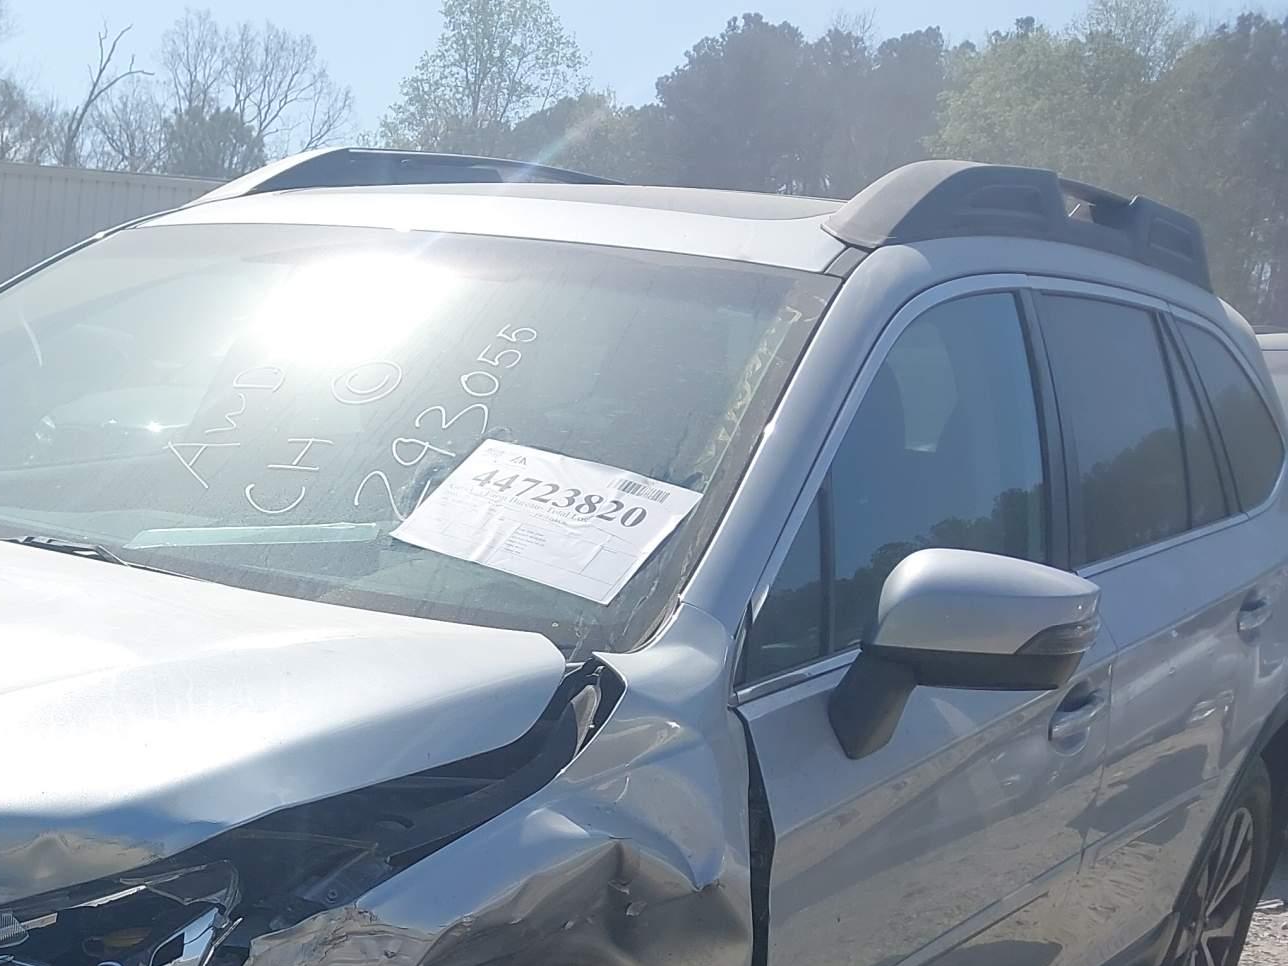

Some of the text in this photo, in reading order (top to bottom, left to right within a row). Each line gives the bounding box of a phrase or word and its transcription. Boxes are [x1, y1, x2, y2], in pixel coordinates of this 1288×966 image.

[353, 323, 538, 521] 293055
[244, 437, 335, 515] CH
[471, 469, 648, 528] 44723820
